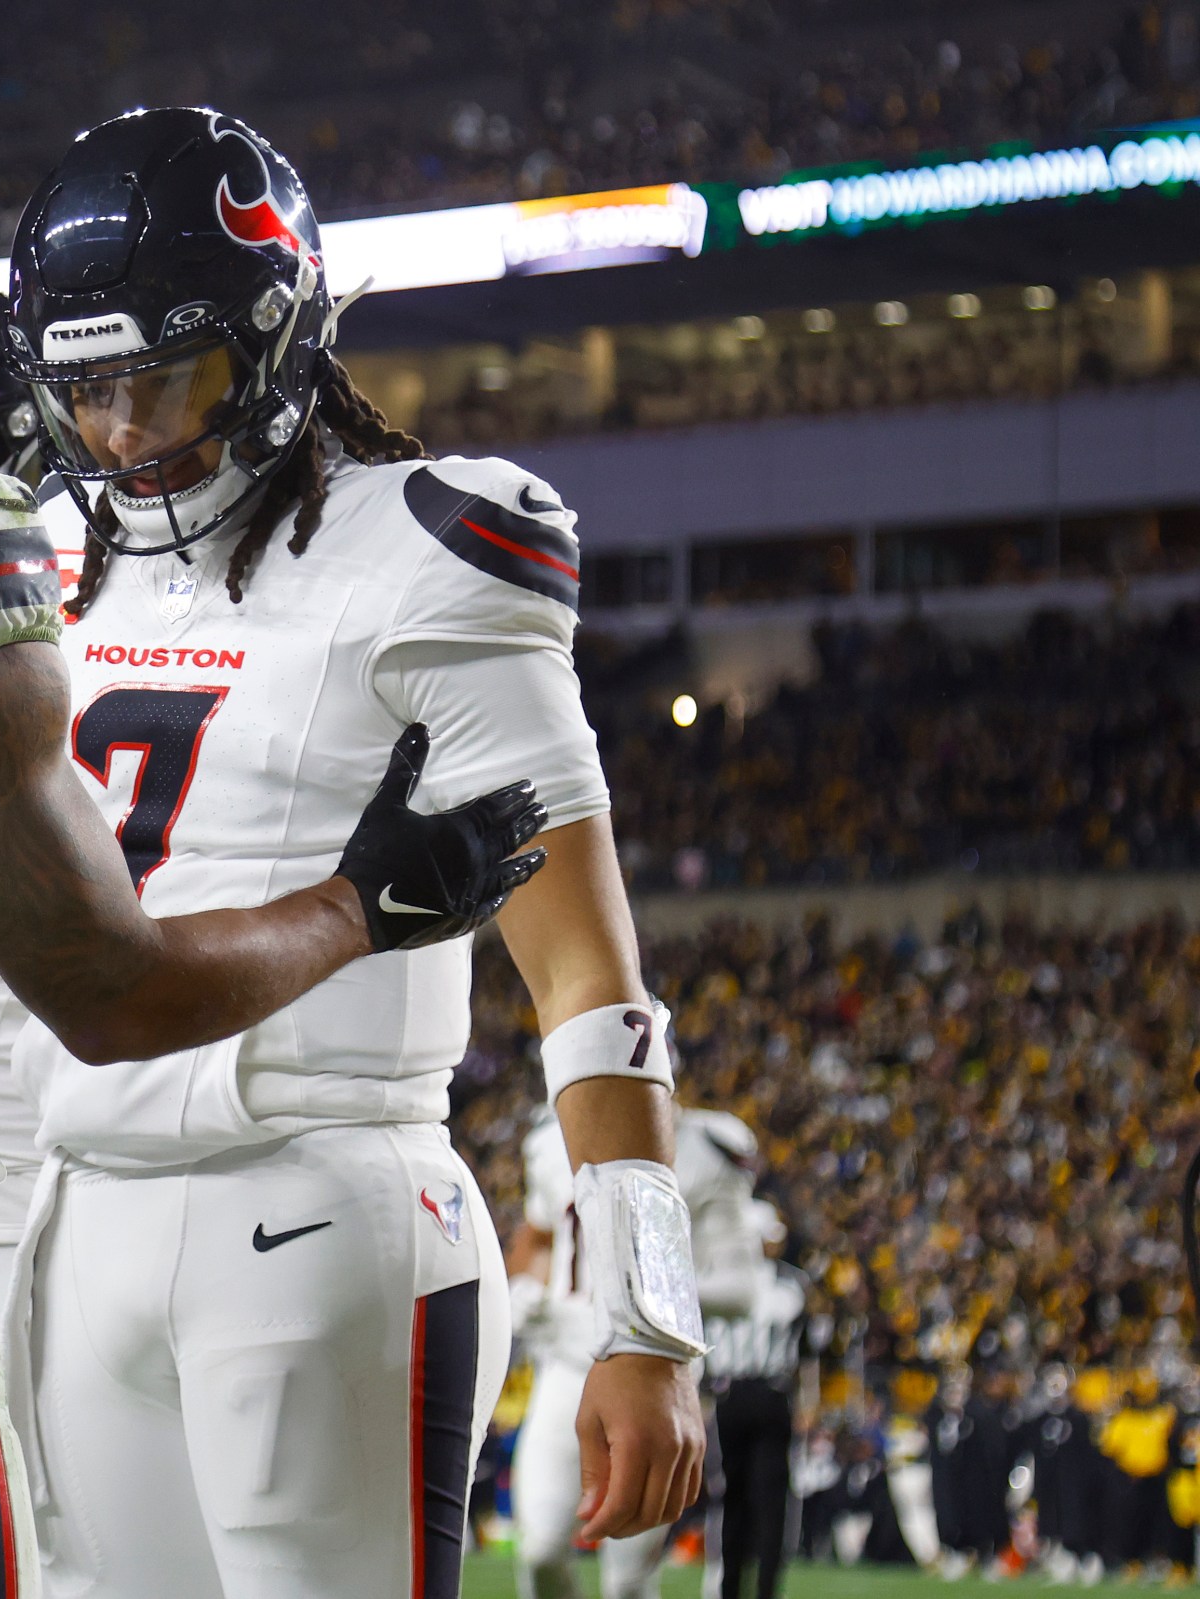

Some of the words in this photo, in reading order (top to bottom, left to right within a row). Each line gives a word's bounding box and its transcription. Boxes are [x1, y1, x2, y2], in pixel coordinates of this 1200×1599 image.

[48, 322, 123, 341] TEXANS
[166, 315, 214, 337] OAKLEY
[85, 644, 245, 669] HOUSTON
[71, 681, 231, 902] 7
[623, 1010, 651, 1068] 7
